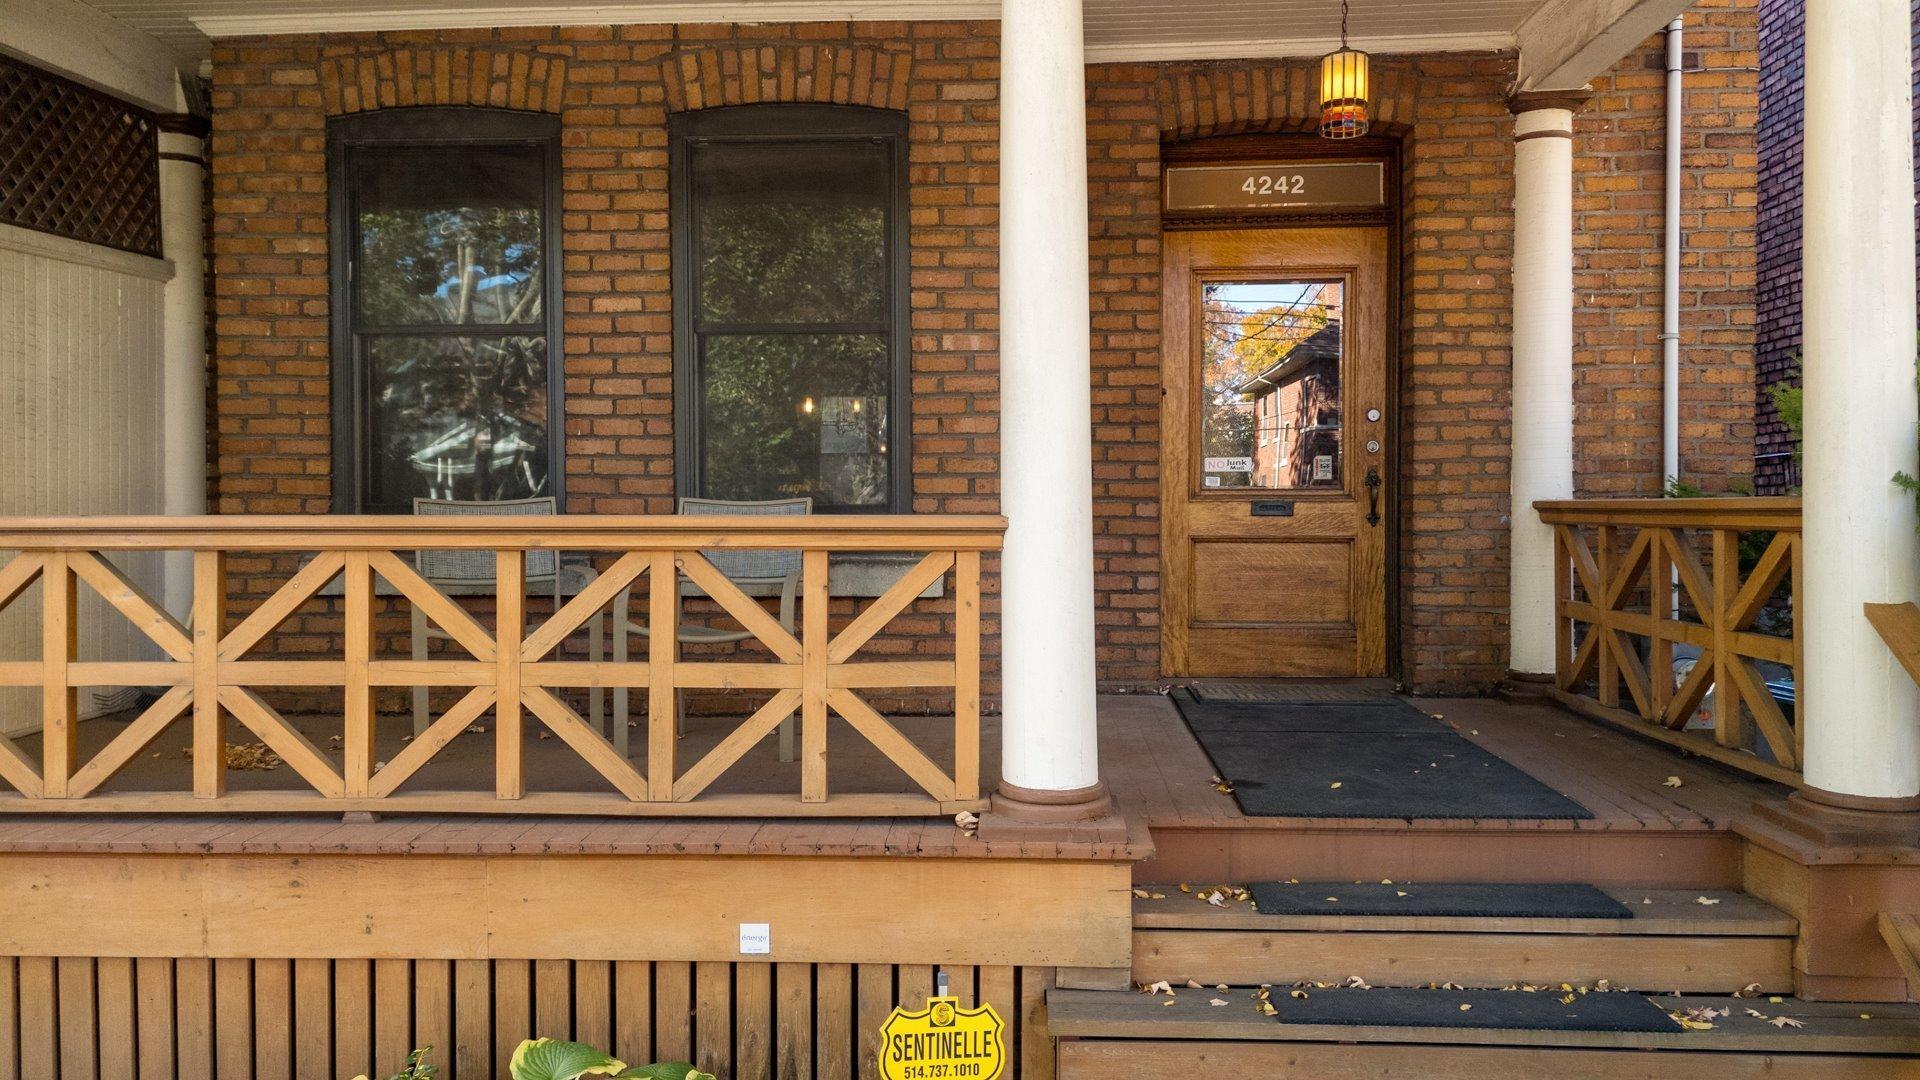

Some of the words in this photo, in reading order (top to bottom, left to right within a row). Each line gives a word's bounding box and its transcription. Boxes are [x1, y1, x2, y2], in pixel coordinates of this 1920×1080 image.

[1241, 175, 1305, 195] 4242
[1208, 461, 1225, 469] NO
[893, 1030, 992, 1063] SENTINELLE
[904, 1063, 980, 1079] 514.737.1010
